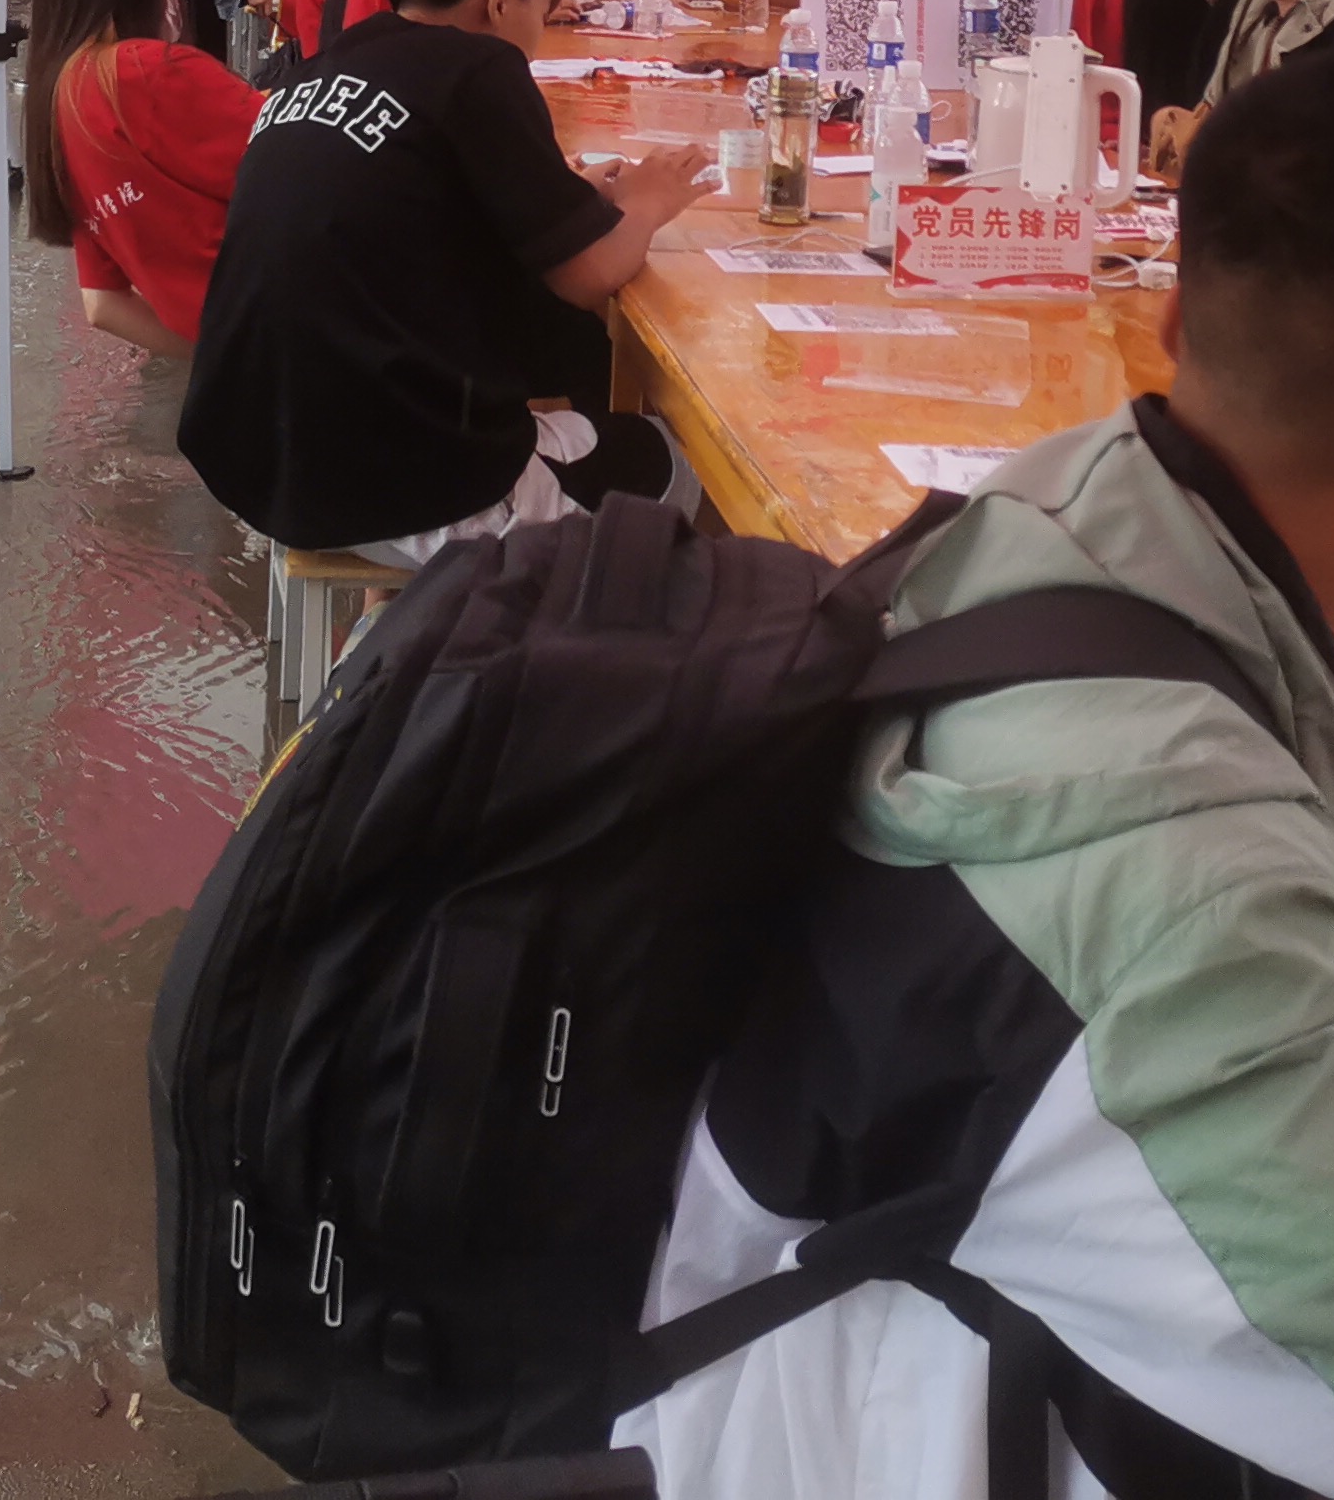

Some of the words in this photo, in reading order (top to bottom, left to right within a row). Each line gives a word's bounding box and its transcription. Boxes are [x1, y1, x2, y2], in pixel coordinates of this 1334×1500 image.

[912, 204, 1082, 241] 党员先锋岗
